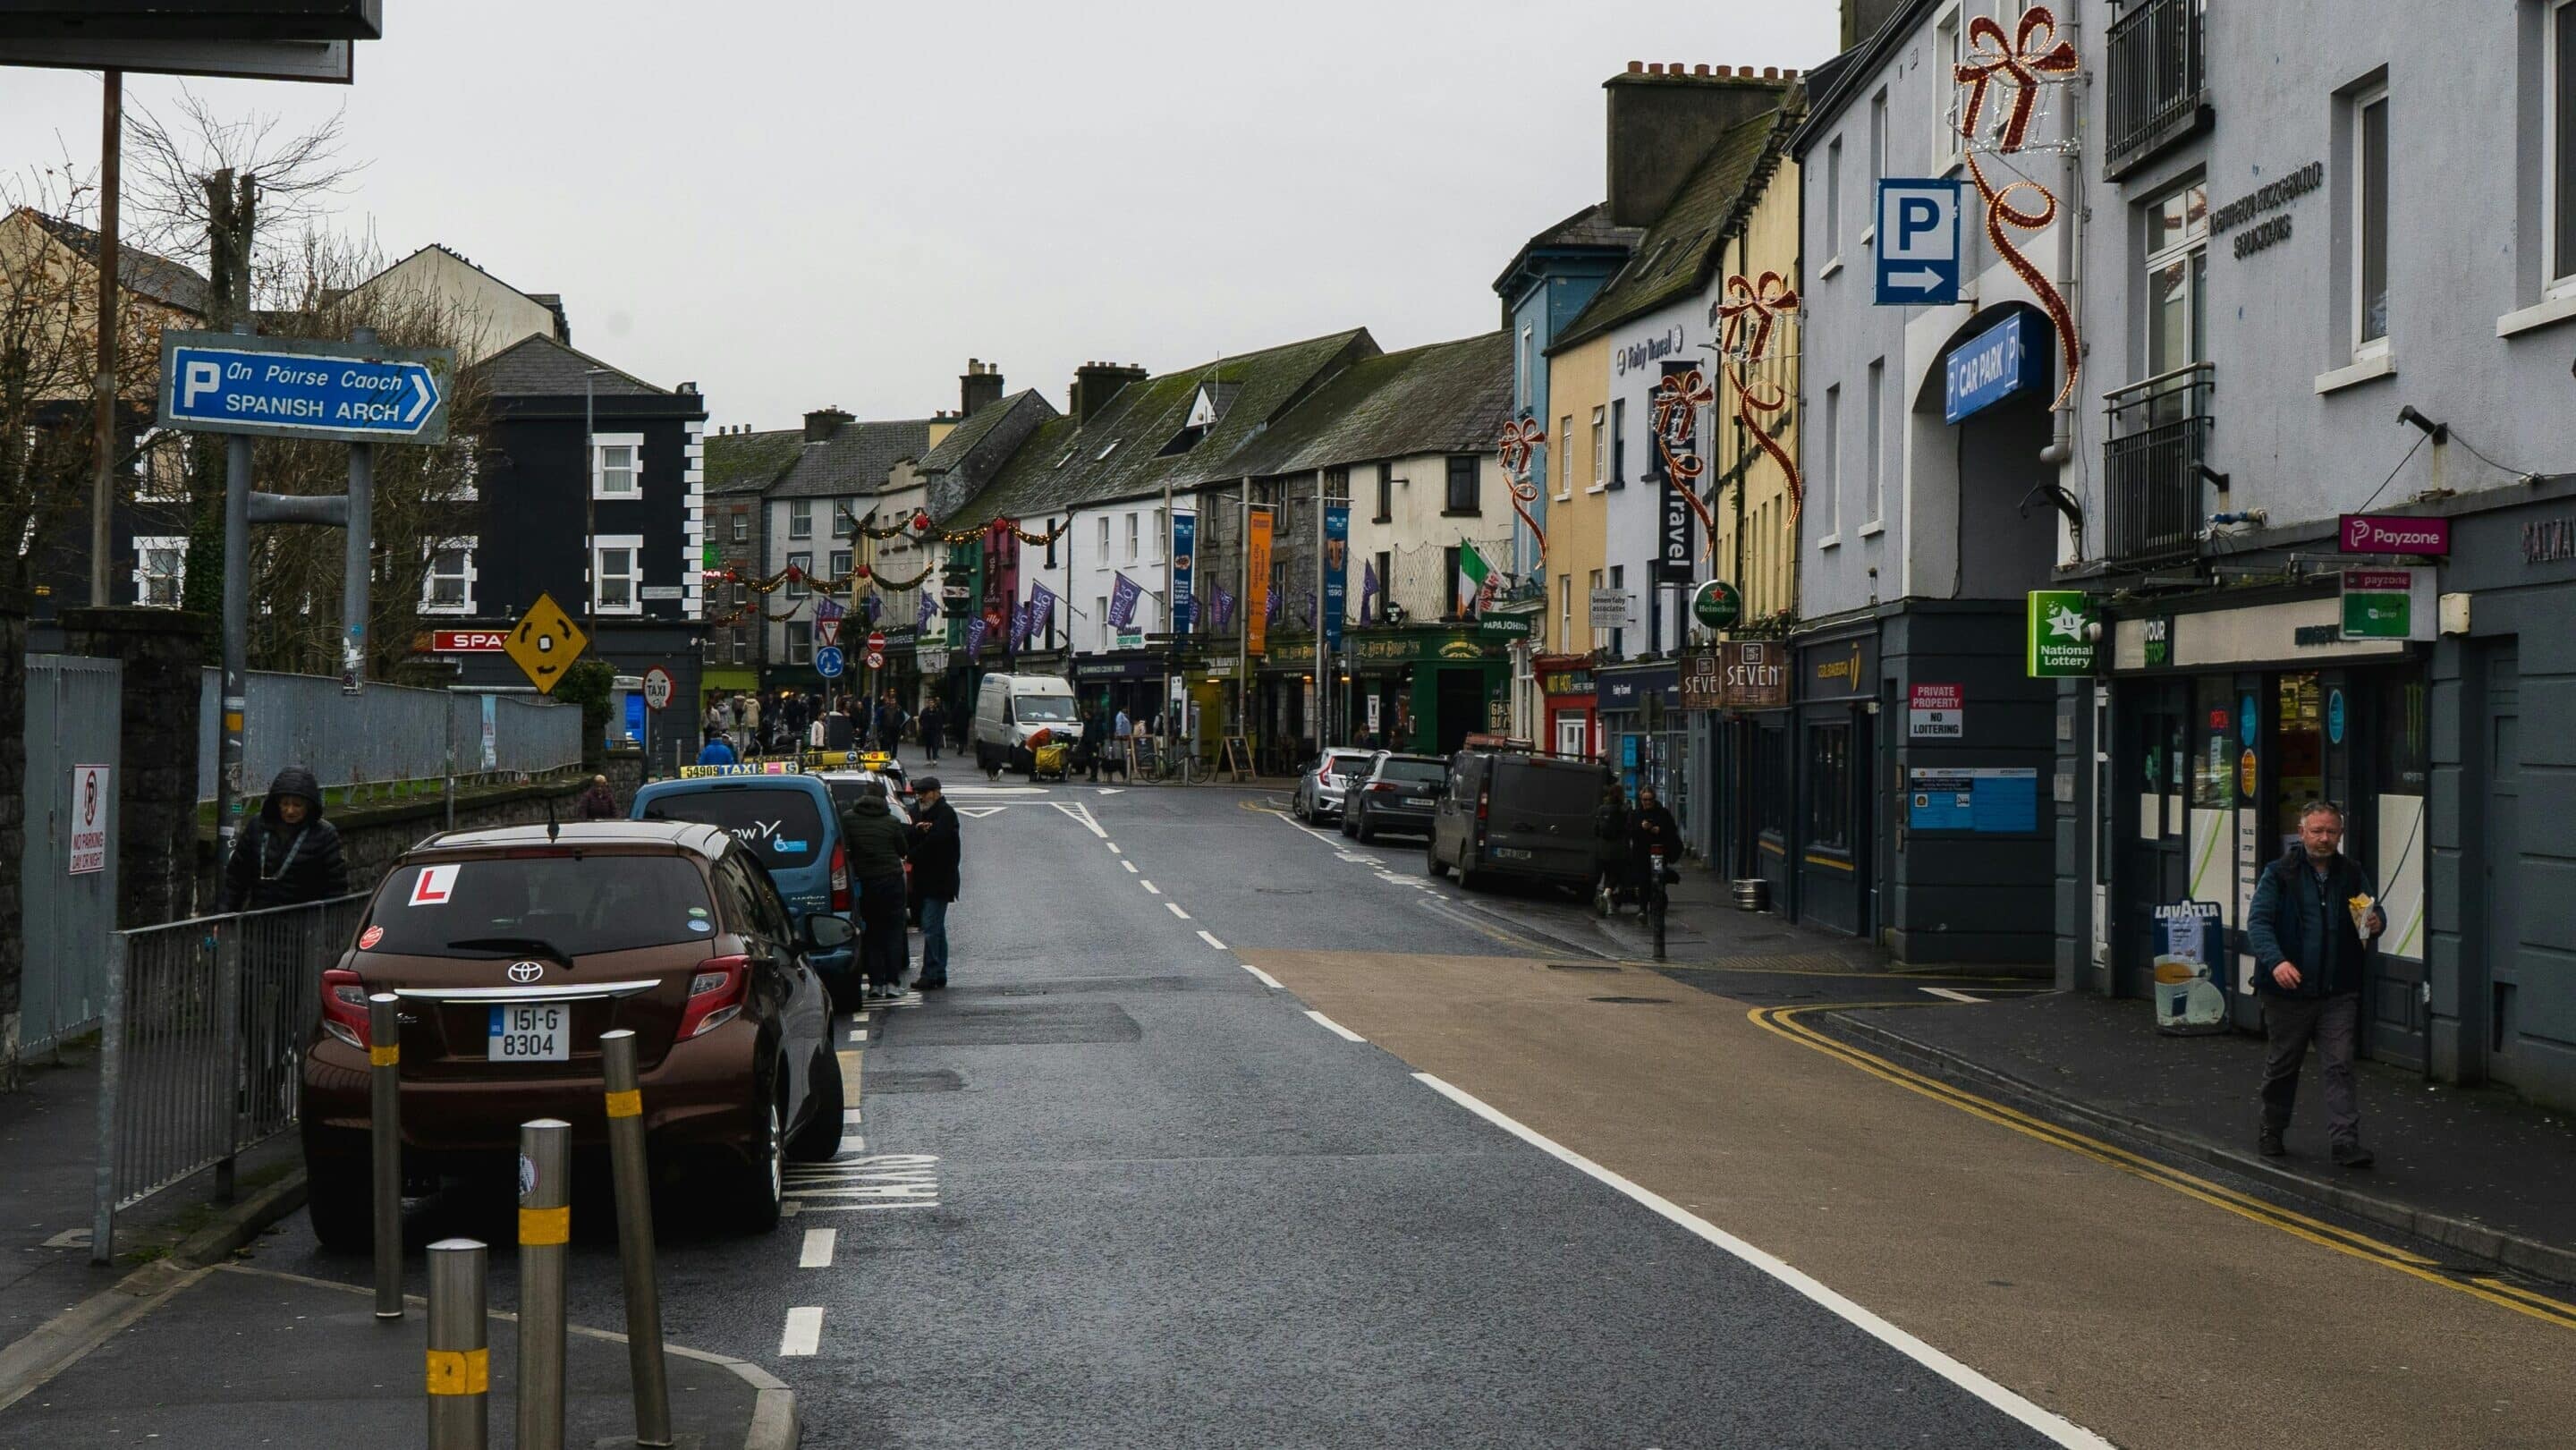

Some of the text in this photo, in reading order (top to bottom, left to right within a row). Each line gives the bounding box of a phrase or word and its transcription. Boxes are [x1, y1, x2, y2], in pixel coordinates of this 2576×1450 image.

[2209, 161, 2323, 236] KENNEDY FITZGERALD
[1900, 198, 1940, 250] P
[2234, 214, 2291, 259] SOLICITORS
[1648, 329, 1671, 361] Travel
[2008, 335, 2016, 374] P
[266, 365, 328, 386] Póirse
[341, 370, 402, 391] Caoch
[1960, 342, 2004, 398] CAR PARK
[183, 360, 221, 408] P
[1949, 372, 1955, 406] P
[225, 394, 400, 422] SPANISH ARCH
[2374, 529, 2439, 547] Payzone
[702, 571, 722, 579] PAR
[2364, 575, 2409, 587] payzone
[1699, 605, 1737, 613] Heineken
[1483, 621, 1503, 630] PAPA
[453, 634, 507, 647] SPA
[2041, 645, 2094, 655] National
[2045, 656, 2090, 668] Lottery
[1685, 676, 1717, 693] SEVE
[1727, 666, 1778, 686] SEVEN
[648, 685, 666, 696] TAXI
[1918, 686, 1955, 696] PRIVATE
[1912, 698, 1960, 708] PROPERTY
[1930, 712, 1943, 722] NO
[1914, 725, 1959, 733] LOITERING
[723, 764, 758, 775] TAXI
[416, 869, 446, 901] L
[2155, 900, 2219, 919] LAVAZZA
[513, 1010, 558, 1030] 151-G
[504, 1035, 554, 1056] 8304
